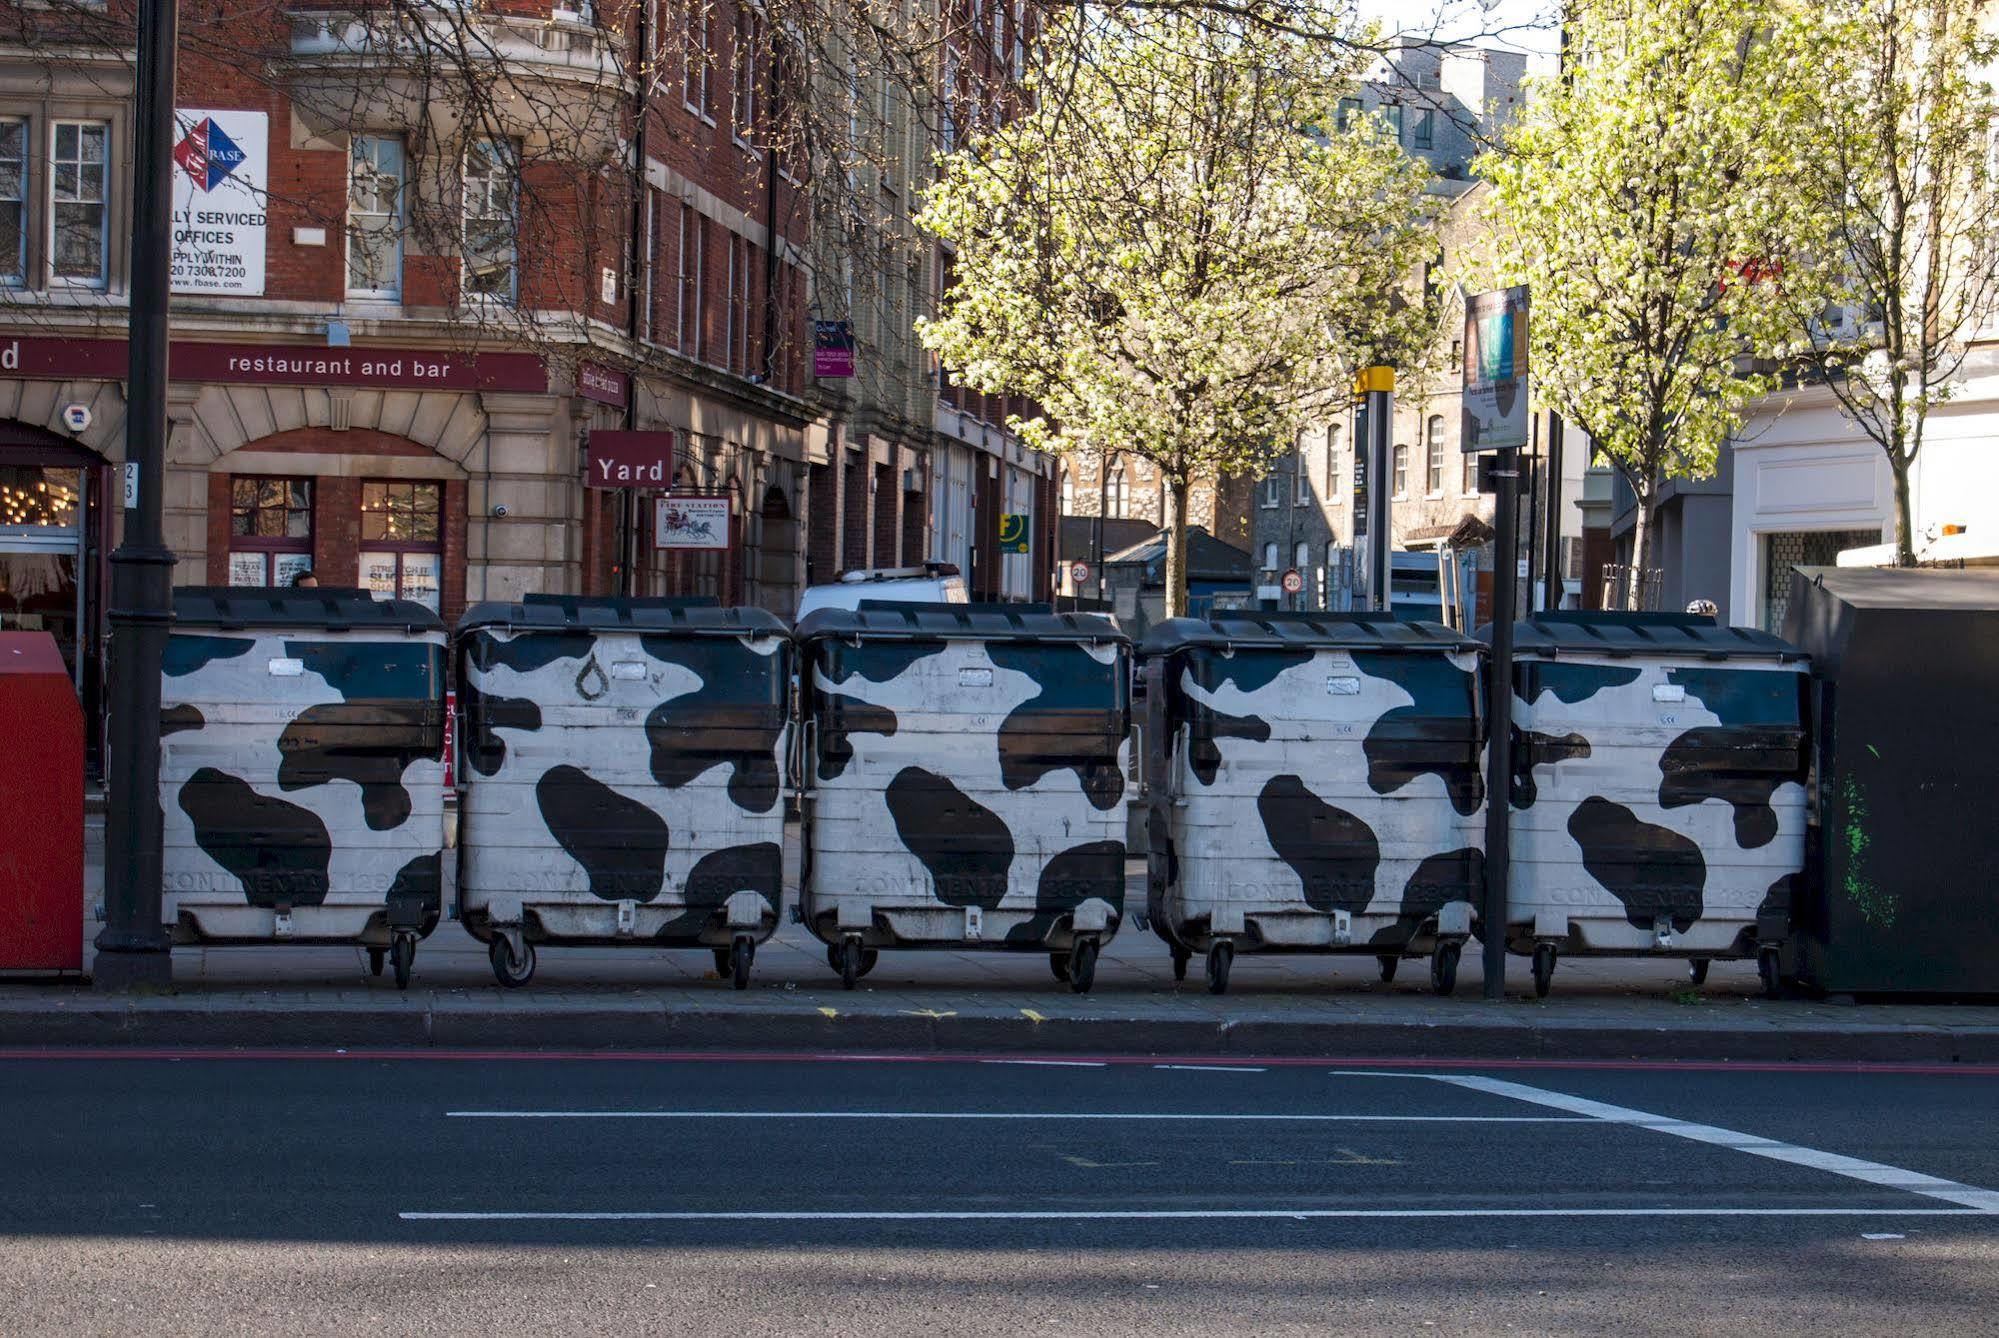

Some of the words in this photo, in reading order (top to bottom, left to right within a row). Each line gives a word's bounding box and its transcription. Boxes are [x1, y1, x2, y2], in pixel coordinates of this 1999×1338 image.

[209, 149, 242, 161] BASE
[197, 212, 266, 226] SERVICED
[175, 231, 234, 244] OFFICES
[202, 254, 242, 265] WITHIN
[217, 267, 246, 278] 7200
[229, 357, 351, 374] restaurant
[361, 361, 402, 376] and
[413, 361, 450, 378] bar
[598, 459, 663, 481] Yard
